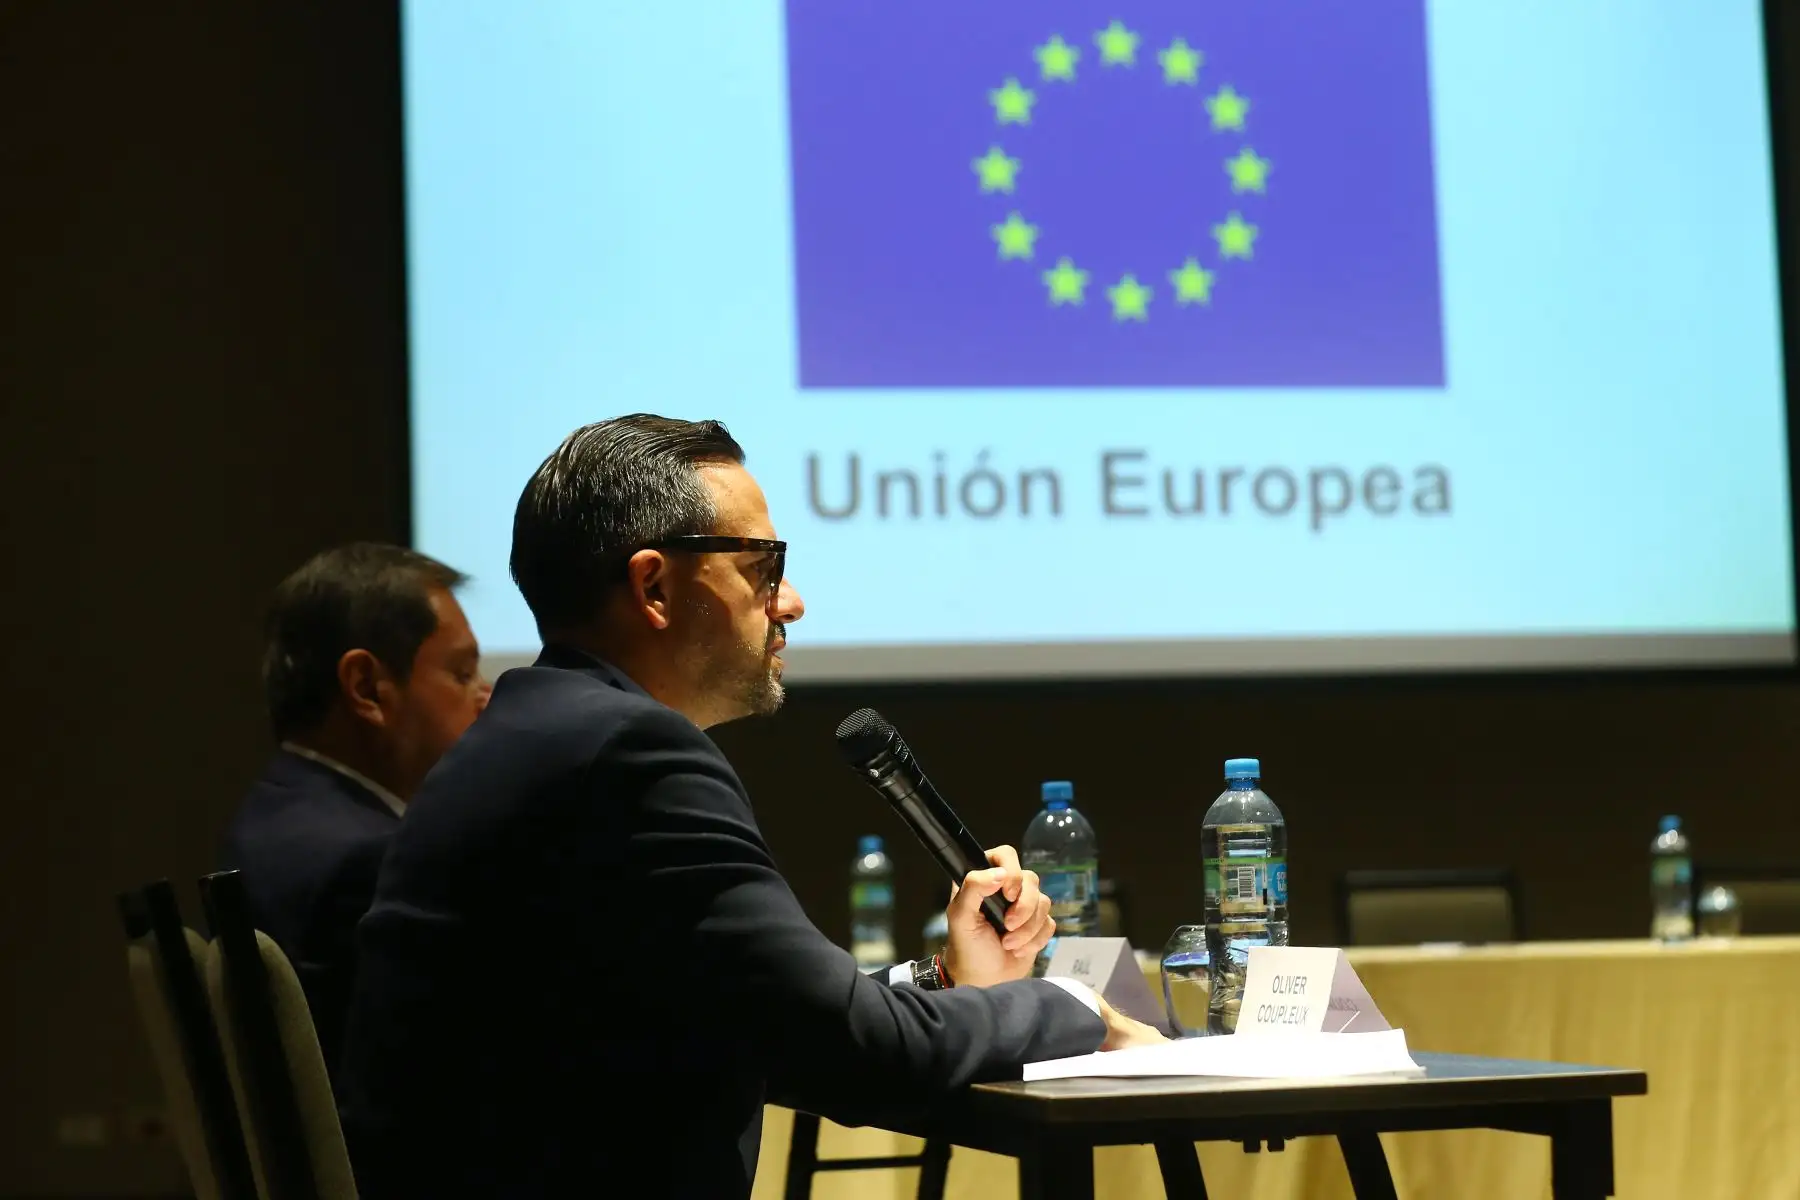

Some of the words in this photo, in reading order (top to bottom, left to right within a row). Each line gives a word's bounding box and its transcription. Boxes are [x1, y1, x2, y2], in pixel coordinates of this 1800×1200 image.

[805, 447, 1065, 521] Unión
[1101, 448, 1453, 534] Europea
[1272, 975, 1307, 995] OLIVER
[1257, 1004, 1309, 1025] COUPLEUX
